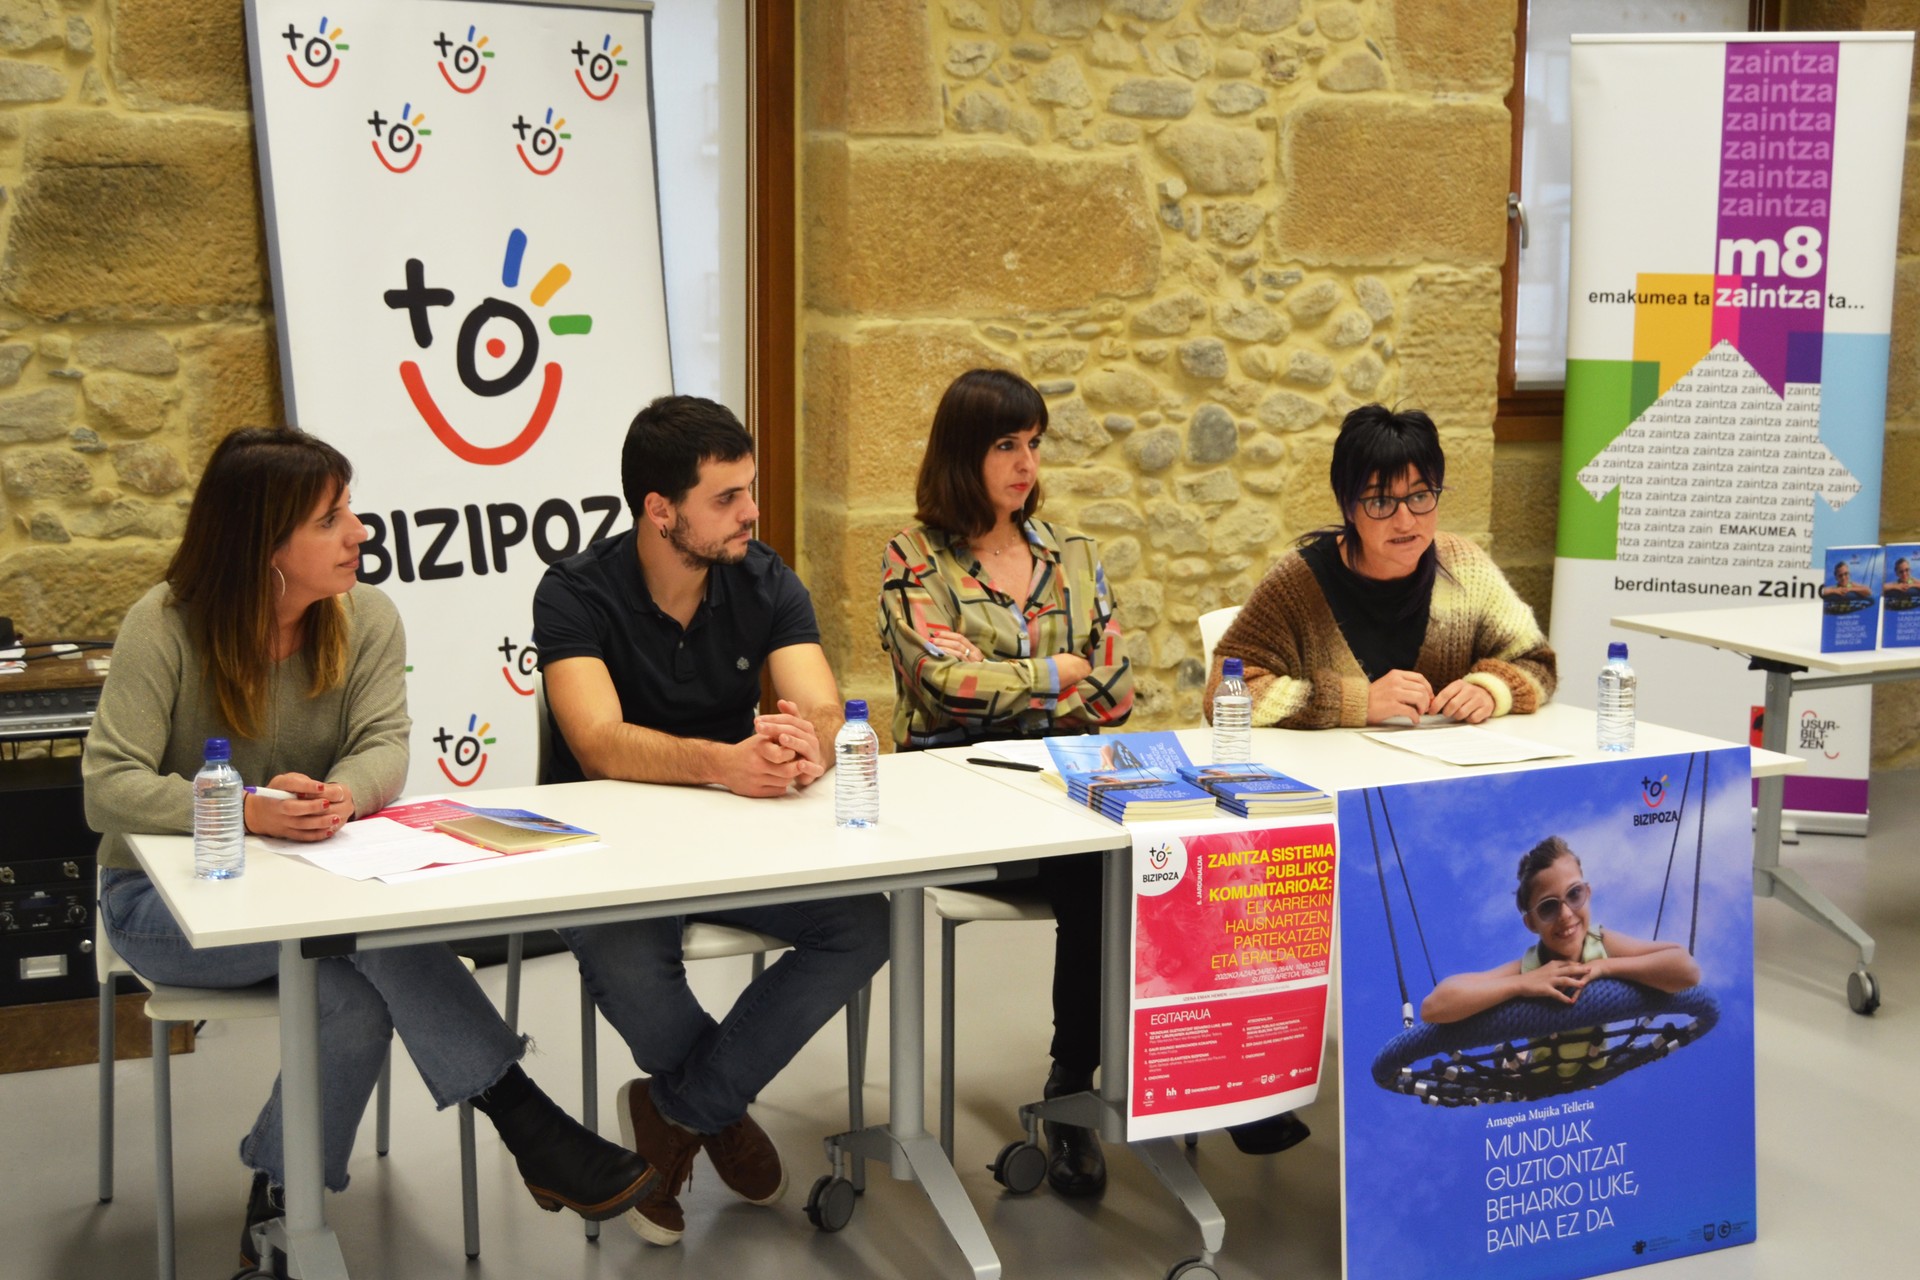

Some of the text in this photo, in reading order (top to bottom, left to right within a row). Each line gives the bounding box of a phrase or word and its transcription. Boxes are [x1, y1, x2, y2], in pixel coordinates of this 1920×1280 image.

[1728, 50, 1834, 74] zaintza
[1727, 78, 1833, 103] zaintza
[1726, 107, 1832, 131] zaintza
[1724, 136, 1830, 160] zaintza
[1723, 164, 1828, 188] zaintza
[1721, 193, 1826, 217] zaintza
[1718, 226, 1822, 278] m8
[1588, 284, 1864, 309] emakumea ta zaintza ta...
[1697, 367, 1738, 378] zaintza
[1696, 383, 1738, 393] zaintza
[1696, 399, 1737, 410] zaintza
[1741, 400, 1782, 411] zaintza
[1650, 414, 1691, 424] zaintza
[1694, 415, 1736, 425] zaintza
[1740, 416, 1781, 427] zaintza
[1649, 429, 1690, 439] zaintza
[1694, 430, 1735, 441] zaintza
[1739, 432, 1780, 442] zaintza
[1648, 444, 1689, 455] zaintza
[1693, 446, 1734, 456] zaintza
[1738, 447, 1780, 458] zaintza
[1784, 449, 1826, 460] zaintza
[1603, 458, 1644, 469] zaintza
[1648, 460, 1688, 471] zaintza
[1692, 461, 1733, 472] zaintza
[1737, 463, 1778, 474] zaintza
[1782, 464, 1824, 476] zaintza
[1602, 474, 1642, 484] zaintza
[1646, 476, 1688, 486] zaintza
[1692, 477, 1732, 488] zaintza
[1736, 478, 1778, 490] zaintza
[1782, 480, 1824, 492] zaintza
[1646, 491, 1686, 502] zaintza
[1691, 492, 1732, 504] zaintza
[1736, 494, 1777, 505] zaintza
[1645, 506, 1686, 517] zaintza
[1690, 508, 1730, 519] zaintza
[1735, 510, 1776, 521] zaintza
[1644, 522, 1685, 533] zaintza
[1720, 524, 1796, 537] EMAKUMEA
[1644, 538, 1684, 548] zaintza
[1688, 539, 1729, 550] zaintza
[1733, 541, 1774, 552] zaintza
[1642, 552, 1684, 564] zaintza
[1688, 554, 1728, 566] zaintza
[1732, 556, 1774, 568] zaintza
[1614, 576, 1752, 596] berdintasunean
[1801, 719, 1840, 730] USUR-
[1801, 728, 1828, 740] BILT-
[1800, 740, 1824, 750] ZEN
[1634, 810, 1678, 827] BIZIPOZA
[1208, 843, 1334, 868] ZAINTZA SISTEMA
[1143, 872, 1179, 883] BIZIPOZA
[1266, 861, 1333, 880] PUBLIKO-
[1209, 877, 1332, 902] KOMUNITARIOAZ:
[1247, 894, 1332, 914] ELKARREKIN
[1225, 910, 1330, 934] HAUSNARTZEN,
[1234, 926, 1330, 950] PARTEKATZEN
[1211, 942, 1329, 969] ETA ERALDATZEN
[1150, 1008, 1211, 1026] EGITARAUA
[1486, 1100, 1594, 1128] Amagoia Mujika Telleria
[1486, 1120, 1592, 1160] MUNDUAK
[1486, 1142, 1627, 1190] GUZTIONTZAT
[1487, 1171, 1639, 1222] BEHARKO LUKE,
[1488, 1206, 1615, 1253] BAINA EZ DA
